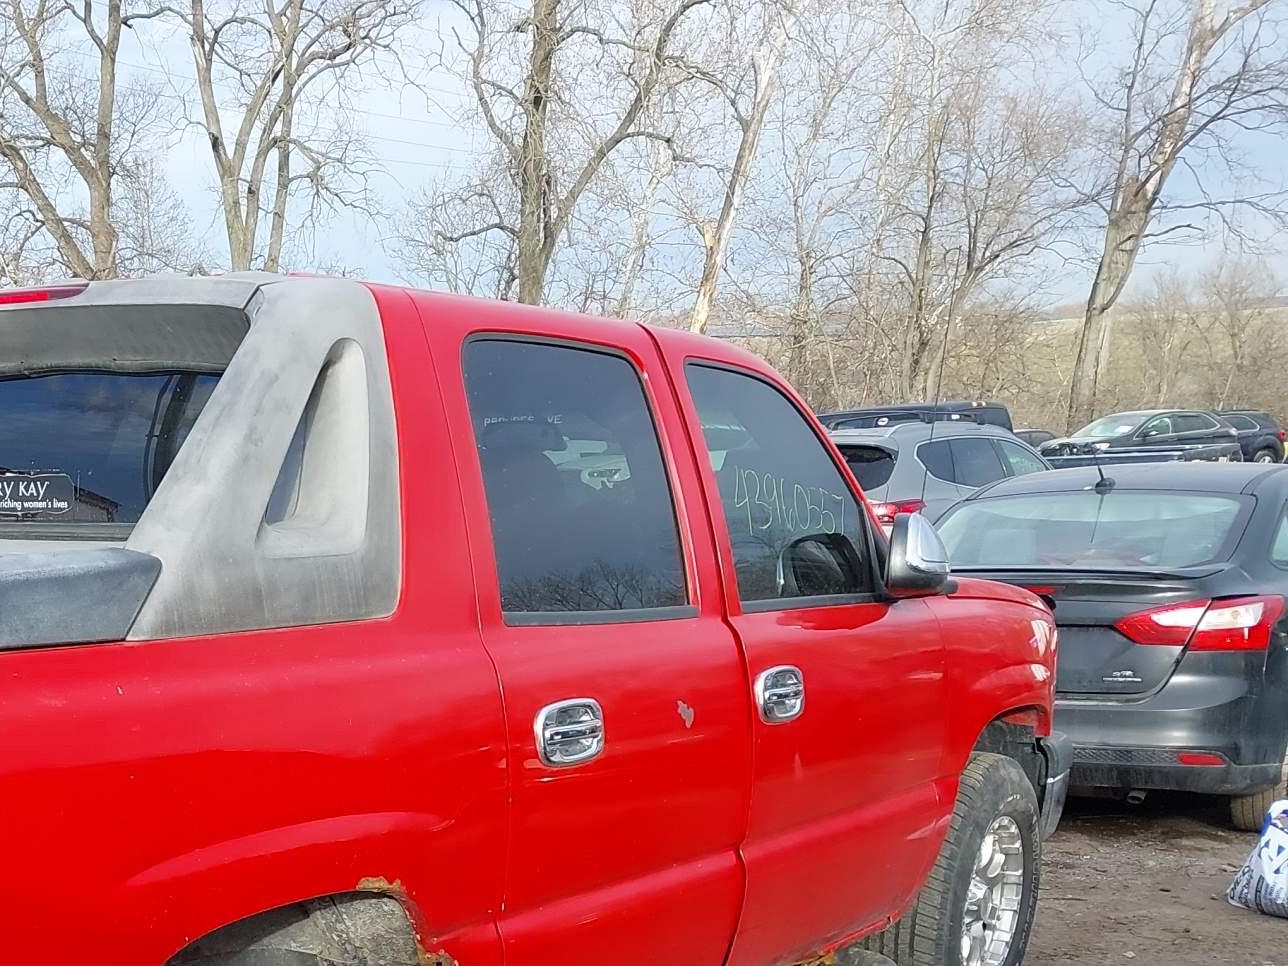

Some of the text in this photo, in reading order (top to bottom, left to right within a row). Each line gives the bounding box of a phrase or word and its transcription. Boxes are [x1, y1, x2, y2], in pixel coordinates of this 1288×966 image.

[18, 481, 48, 500] KAY
[23, 499, 51, 508] women's
[53, 498, 68, 508] lives
[734, 465, 845, 537] 43960557
